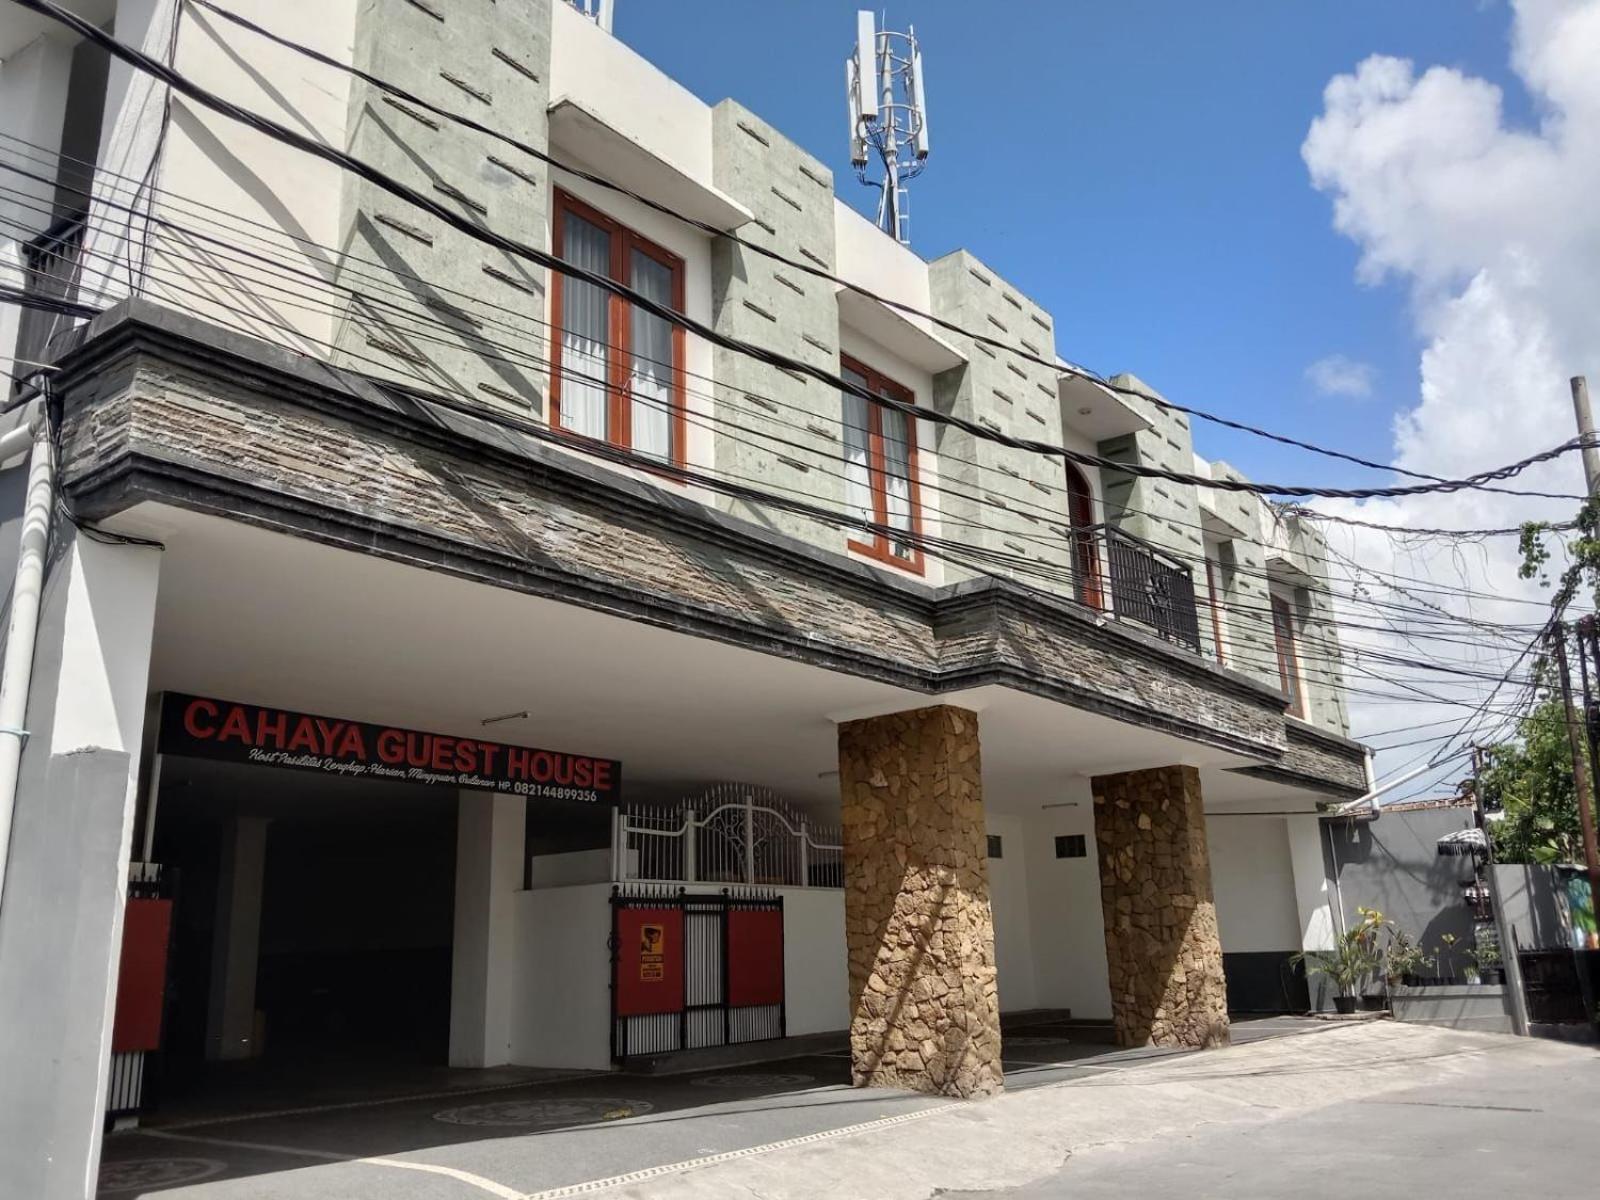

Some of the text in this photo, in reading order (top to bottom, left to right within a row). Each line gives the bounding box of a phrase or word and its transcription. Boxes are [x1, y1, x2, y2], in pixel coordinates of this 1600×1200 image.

[183, 698, 613, 790] CAHAYA GUEST HOUSE
[514, 781, 598, 802] 082144899356
